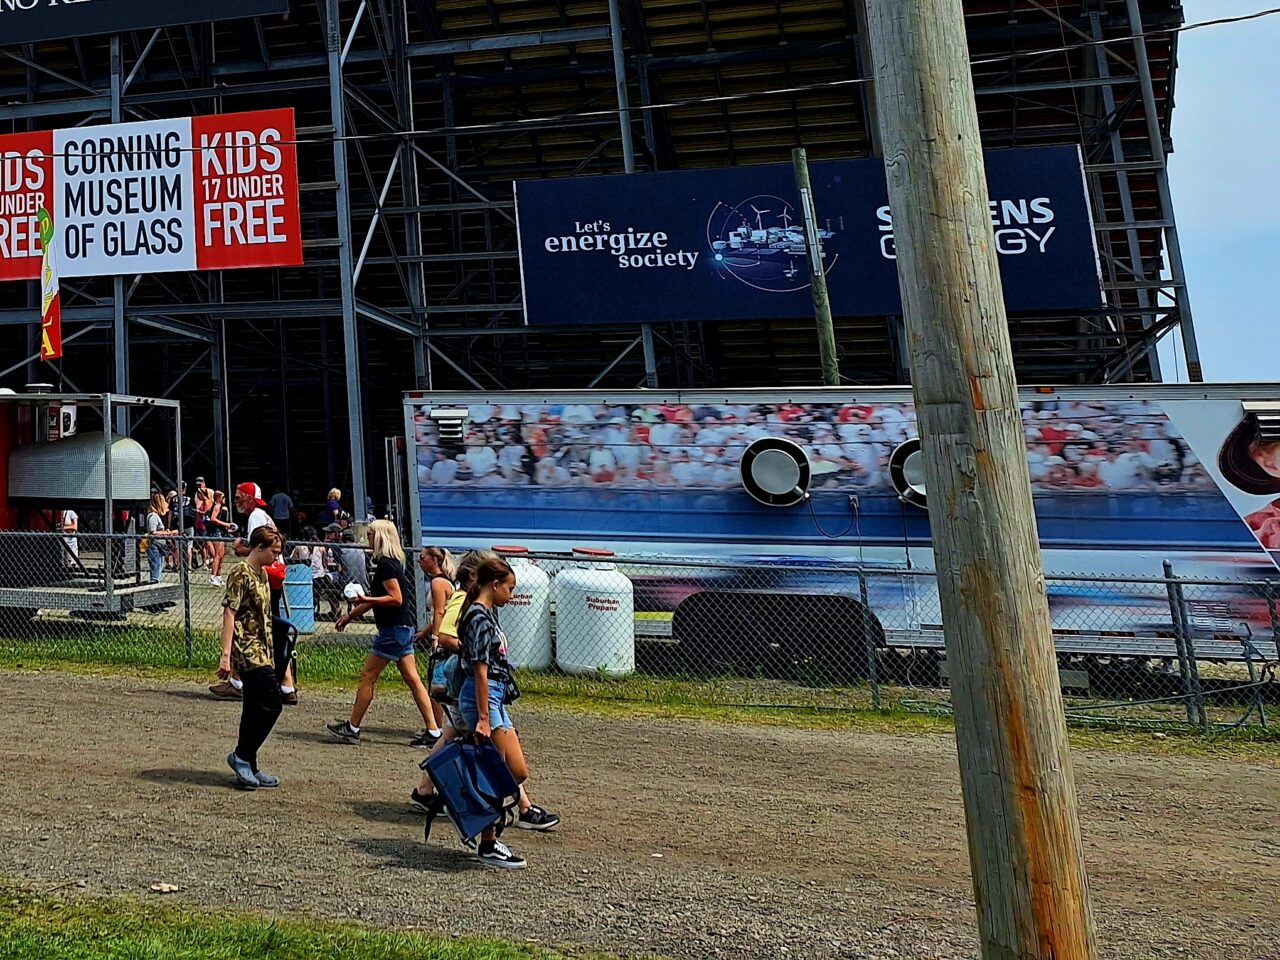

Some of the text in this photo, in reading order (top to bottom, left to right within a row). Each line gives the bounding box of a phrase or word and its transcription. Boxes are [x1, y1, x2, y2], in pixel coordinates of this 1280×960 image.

[64, 131, 180, 176] CORNING
[201, 128, 282, 176] KIDS
[64, 173, 182, 218] MUSEUM
[203, 173, 284, 201] 17 UNDER
[203, 198, 287, 246] FREE
[575, 220, 610, 233] Let's
[876, 197, 1055, 231] SENS
[63, 218, 183, 259] OF GLASS
[544, 227, 668, 255] energize
[619, 249, 699, 270] society
[585, 596, 620, 605] Suburban
[587, 603, 618, 611] Propane
